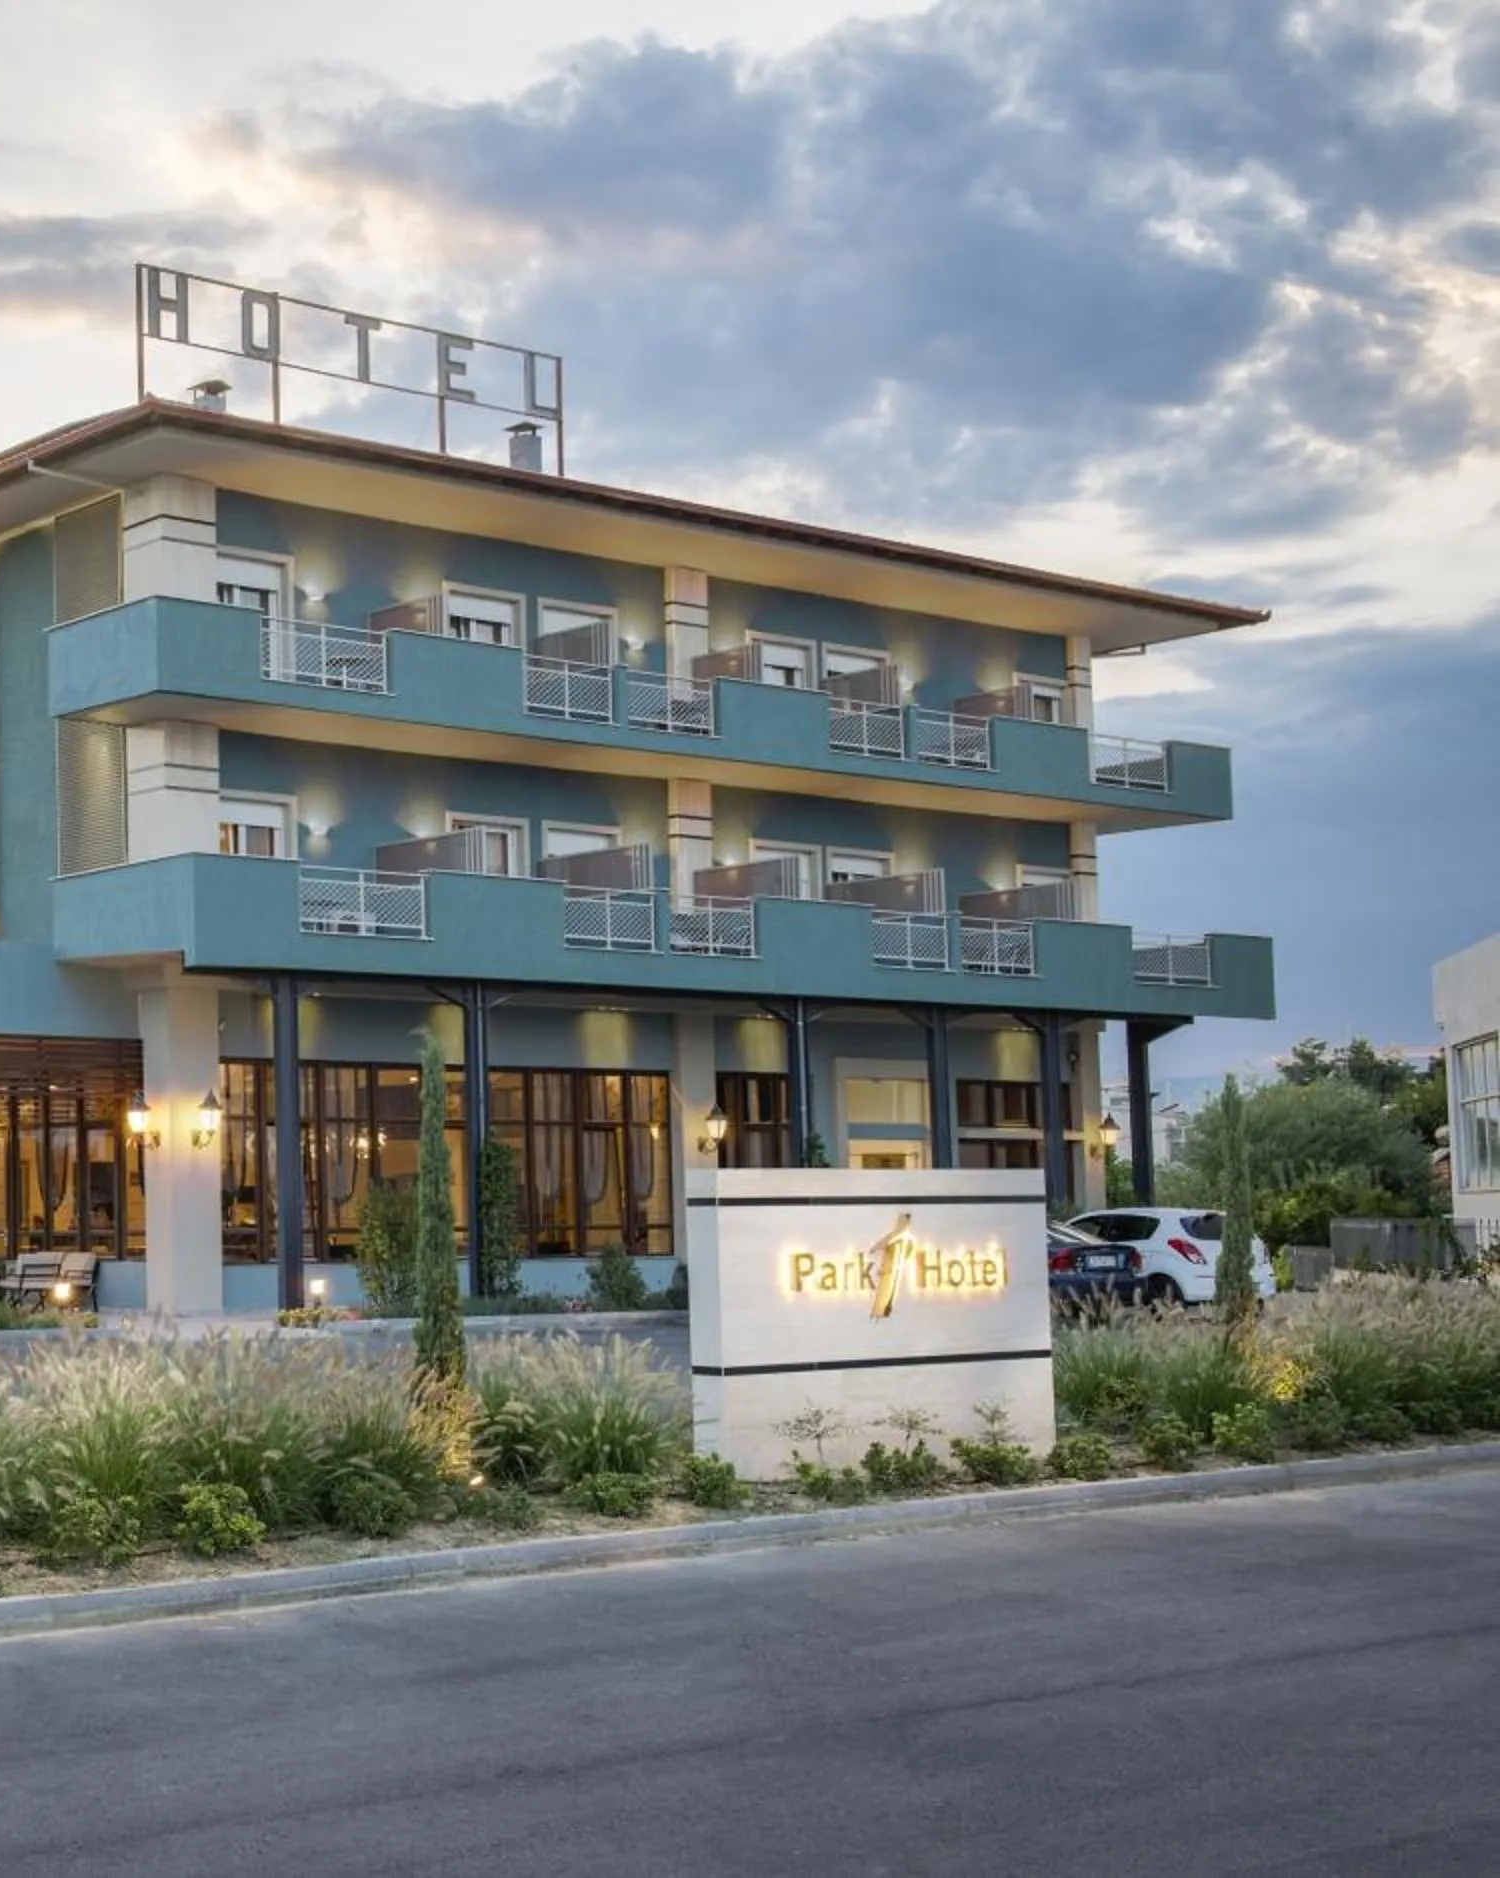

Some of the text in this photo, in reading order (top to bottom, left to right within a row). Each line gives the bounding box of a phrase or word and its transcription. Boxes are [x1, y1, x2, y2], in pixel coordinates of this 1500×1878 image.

[147, 266, 561, 420] HOTEL
[790, 1246, 1010, 1292] Park Hotel
